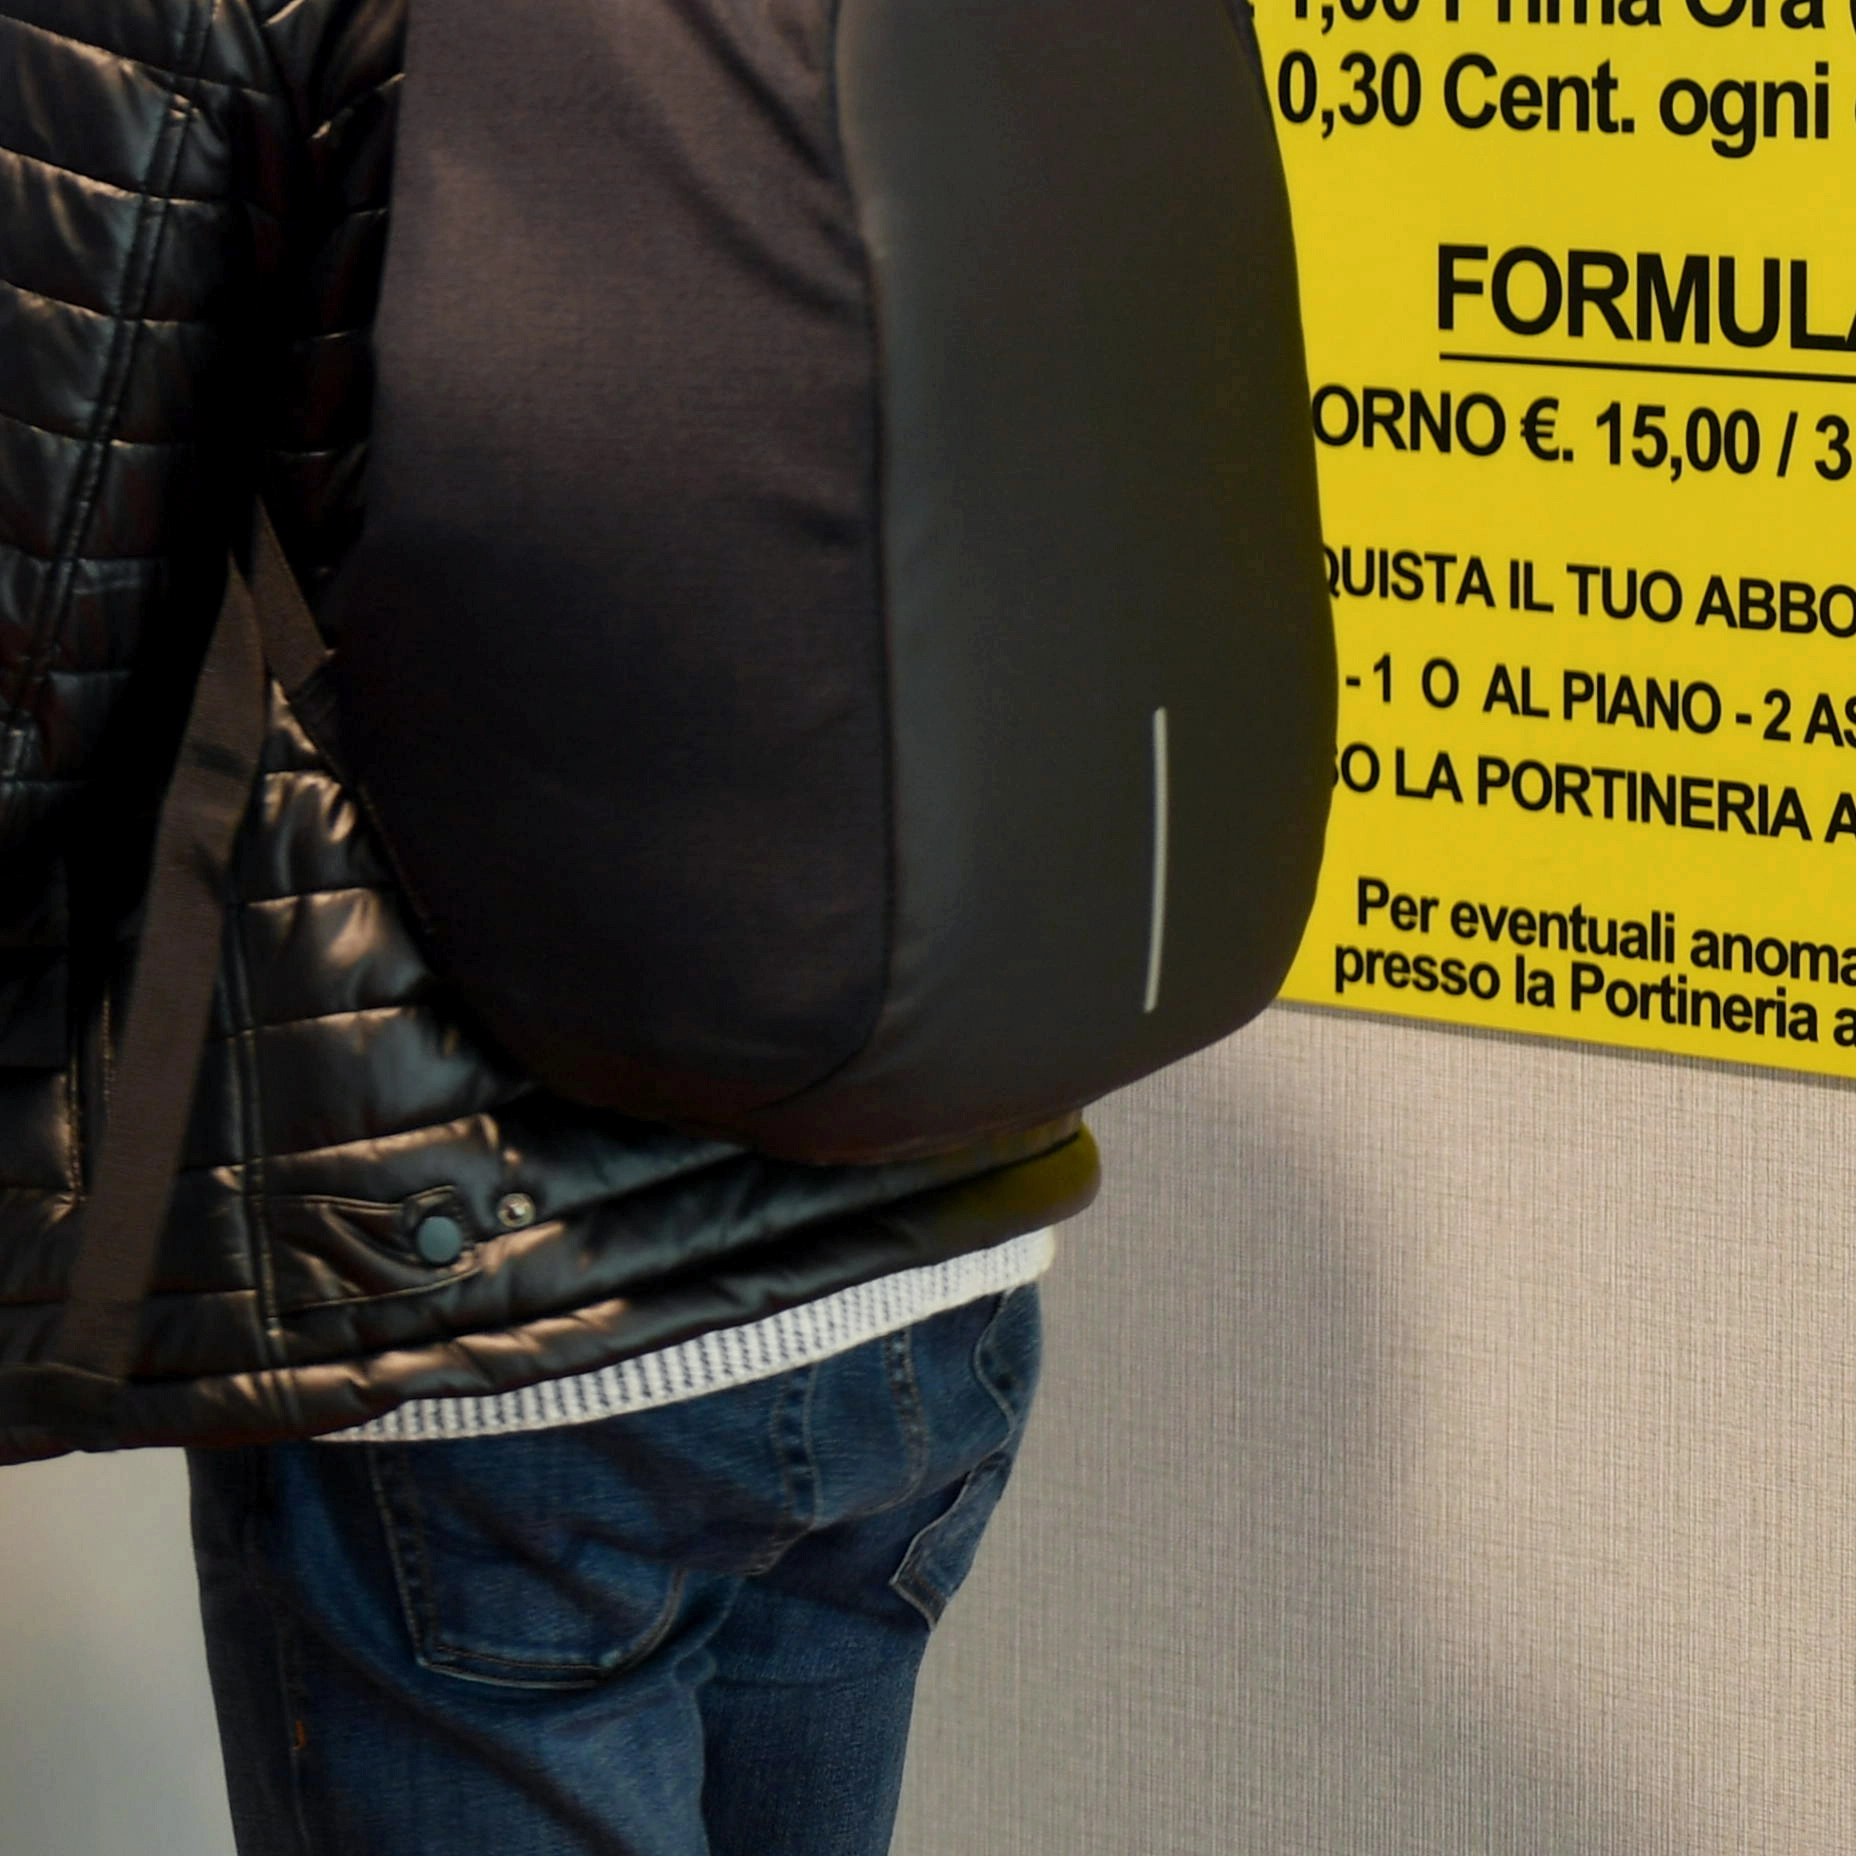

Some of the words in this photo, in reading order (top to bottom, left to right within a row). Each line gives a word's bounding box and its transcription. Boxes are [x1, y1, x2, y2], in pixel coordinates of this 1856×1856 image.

[1277, 49, 1422, 139] 0,30
[1443, 52, 1635, 134] Cent.
[1659, 61, 1829, 159] ogni
[1438, 243, 1856, 353] FORMUL
[1312, 384, 1506, 457] ORNO
[1520, 396, 1574, 462] €.
[1596, 401, 1761, 483] 15,00
[1509, 559, 1555, 613] IL
[1566, 564, 1683, 624] TUO
[1421, 657, 1460, 709] O
[1482, 664, 1550, 719] AL
[1563, 670, 1722, 735] PIANO
[1332, 742, 1381, 794] O
[1395, 747, 1464, 803] LA
[1477, 755, 1813, 841] PORTINERIA
[1357, 876, 1440, 934] Per
[1450, 901, 1675, 964] eventuali
[1335, 945, 1501, 1001] presso
[1515, 954, 1555, 1010] la
[1571, 961, 1819, 1043] Portineria
